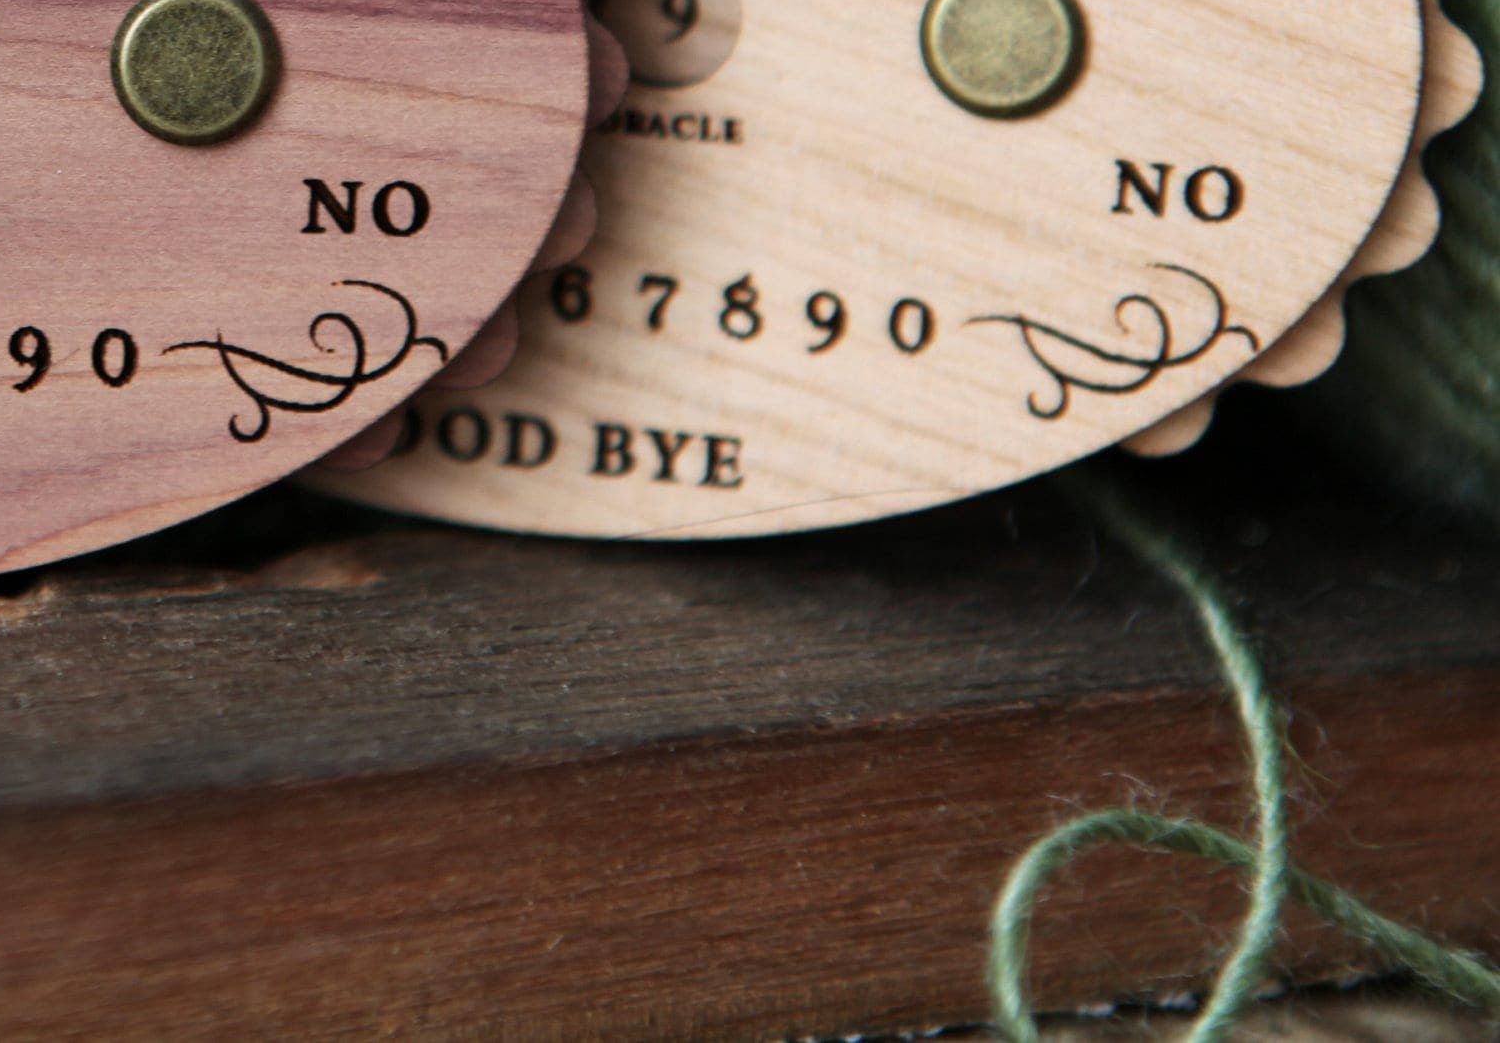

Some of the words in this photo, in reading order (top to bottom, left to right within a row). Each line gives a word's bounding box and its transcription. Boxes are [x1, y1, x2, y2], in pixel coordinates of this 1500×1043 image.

[300, 178, 431, 238] NO
[1111, 159, 1244, 223] NO
[550, 267, 593, 324] 6
[637, 272, 678, 332] 7
[718, 275, 762, 341] 8
[805, 291, 847, 353] 9
[888, 297, 935, 355] 0
[8, 325, 52, 394] 9
[91, 327, 139, 388] 0
[589, 421, 744, 489] BYE
